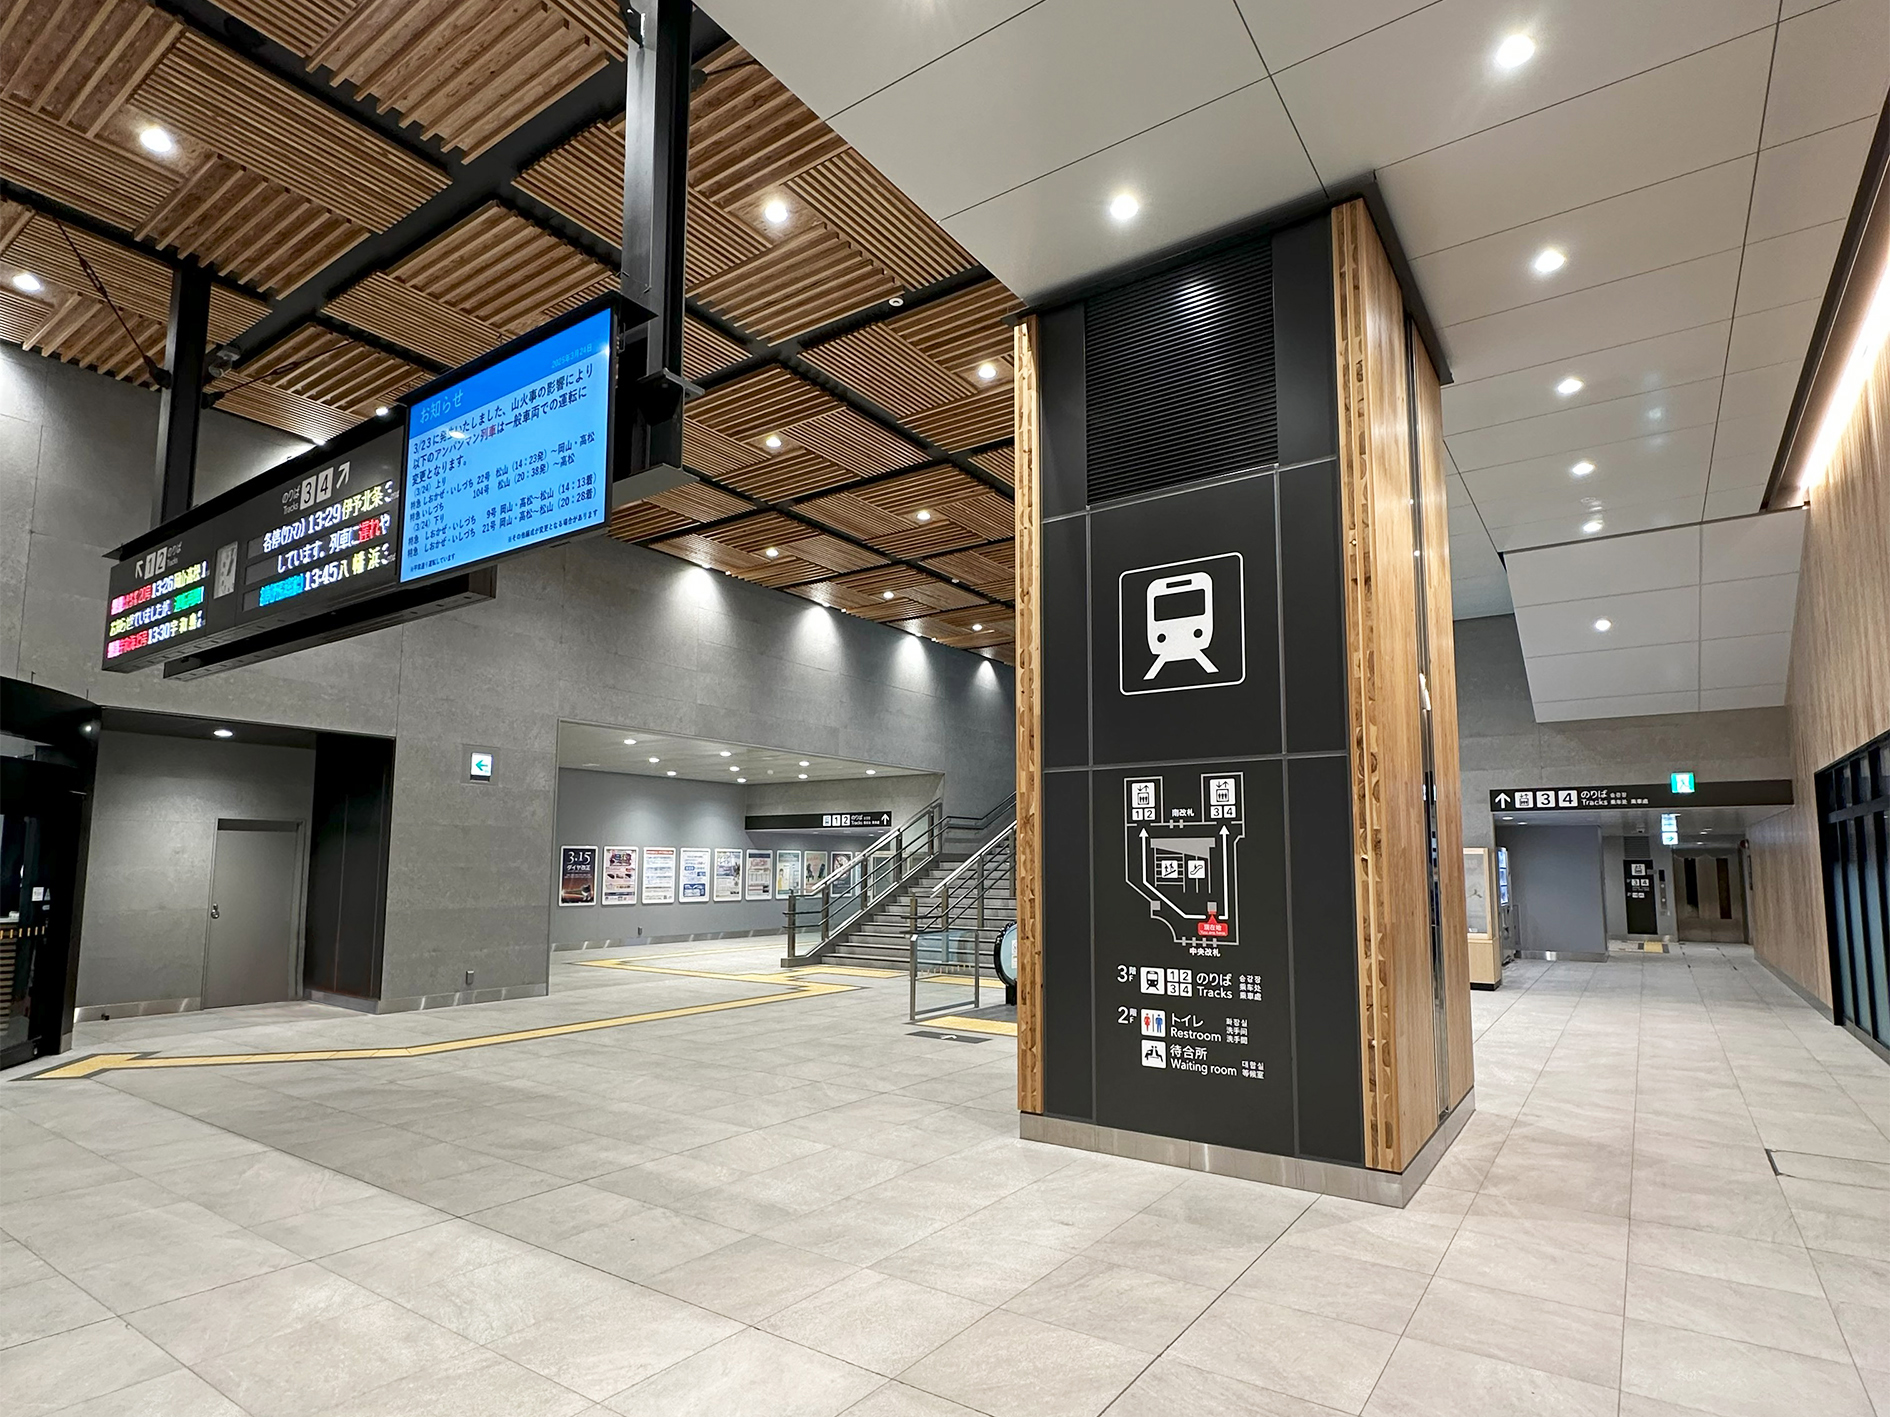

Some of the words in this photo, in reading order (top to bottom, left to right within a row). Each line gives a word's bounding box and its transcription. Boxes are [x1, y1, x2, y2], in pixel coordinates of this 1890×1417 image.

[419, 389, 464, 424] お知らせ
[281, 485, 300, 503] のりば
[305, 482, 312, 503] 3
[320, 474, 328, 495] 4
[308, 504, 341, 534] 13:29
[342, 485, 383, 520] 伊予北条
[304, 562, 339, 591] 13:45
[1541, 793, 1550, 805] 3
[1563, 792, 1574, 805] 4
[1580, 790, 1608, 798] のりば
[567, 851, 591, 864] 3.15
[1189, 948, 1221, 957] 中央改札
[1196, 972, 1232, 986] のりば
[1196, 986, 1233, 999] Tracks
[1171, 1012, 1204, 1027] トイレ
[1170, 1027, 1222, 1042] Restroom
[1170, 1044, 1207, 1060] 待合所
[1170, 1058, 1208, 1075] Waiting
[1210, 1065, 1237, 1076] room
